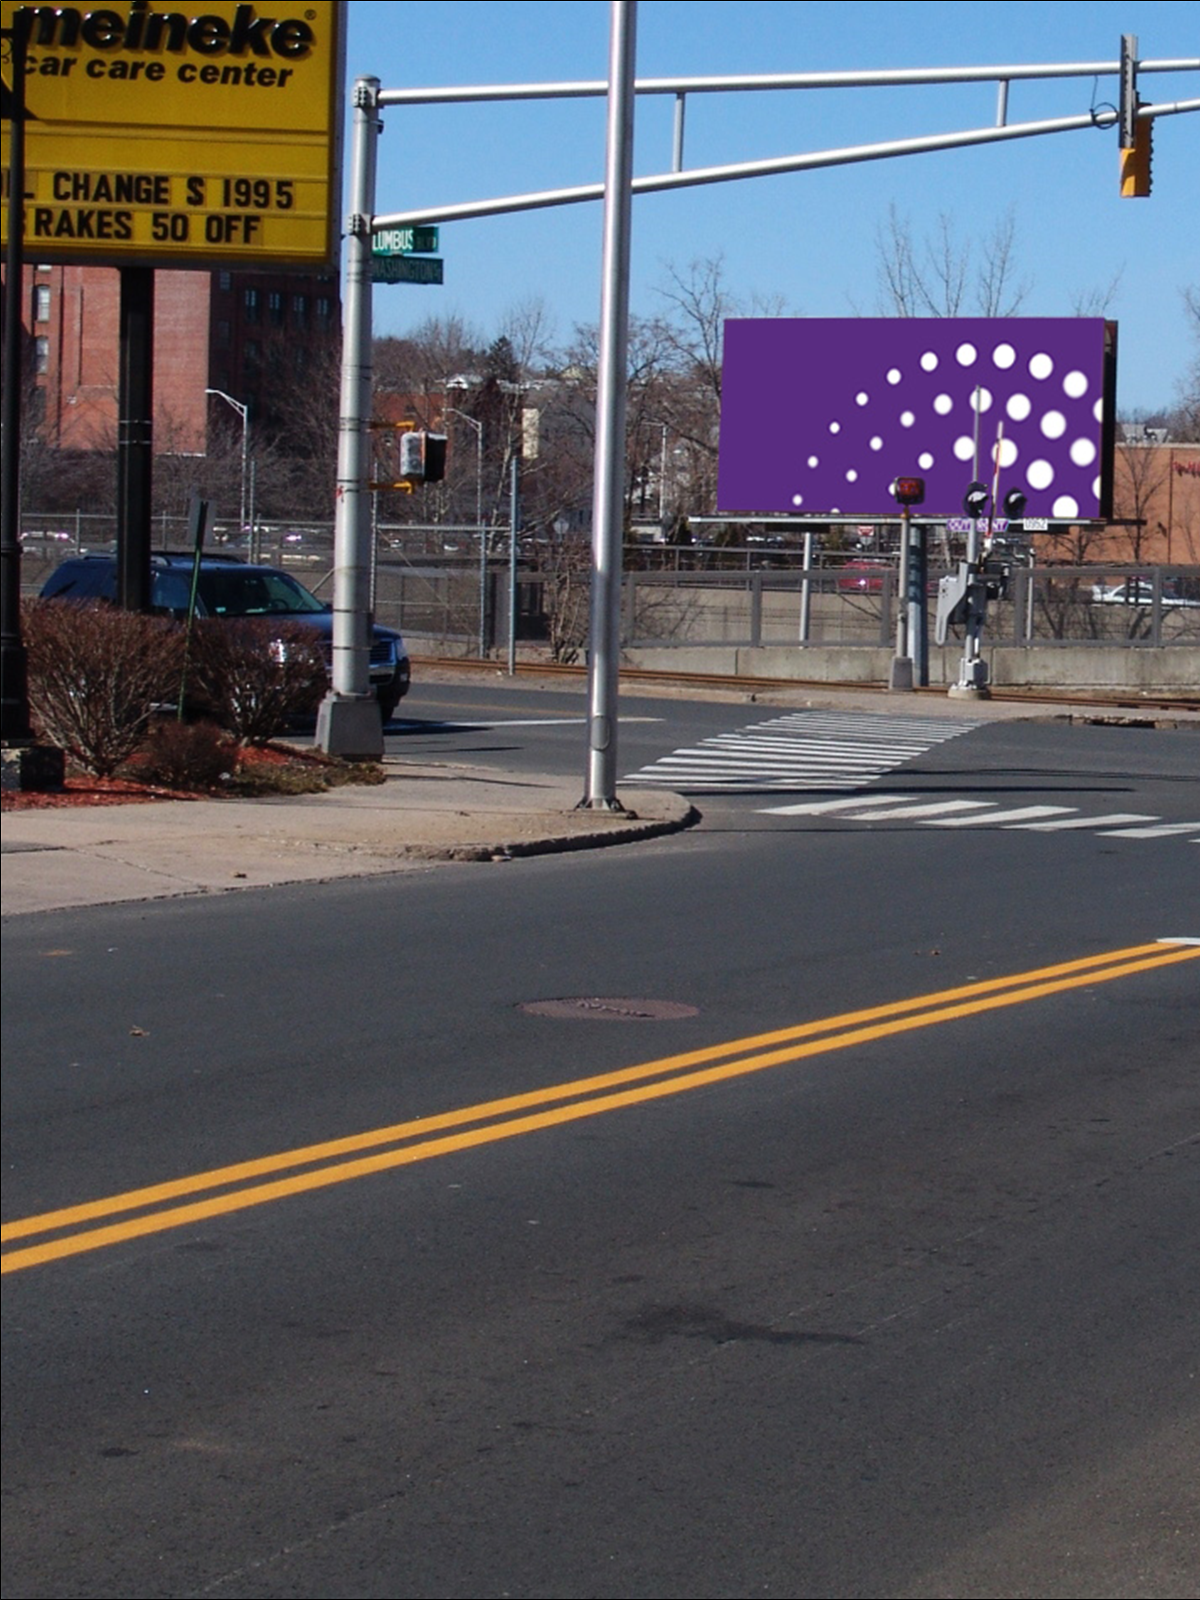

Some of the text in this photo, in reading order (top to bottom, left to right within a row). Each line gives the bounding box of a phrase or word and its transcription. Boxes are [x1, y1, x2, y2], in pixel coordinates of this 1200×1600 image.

[21, 1, 314, 59] meineke
[25, 55, 293, 87] car care center
[53, 172, 169, 204] CHANGE
[223, 179, 293, 209] 1995
[23, 208, 261, 243] RAKES 50 OFF
[372, 229, 414, 251] LUMBUS
